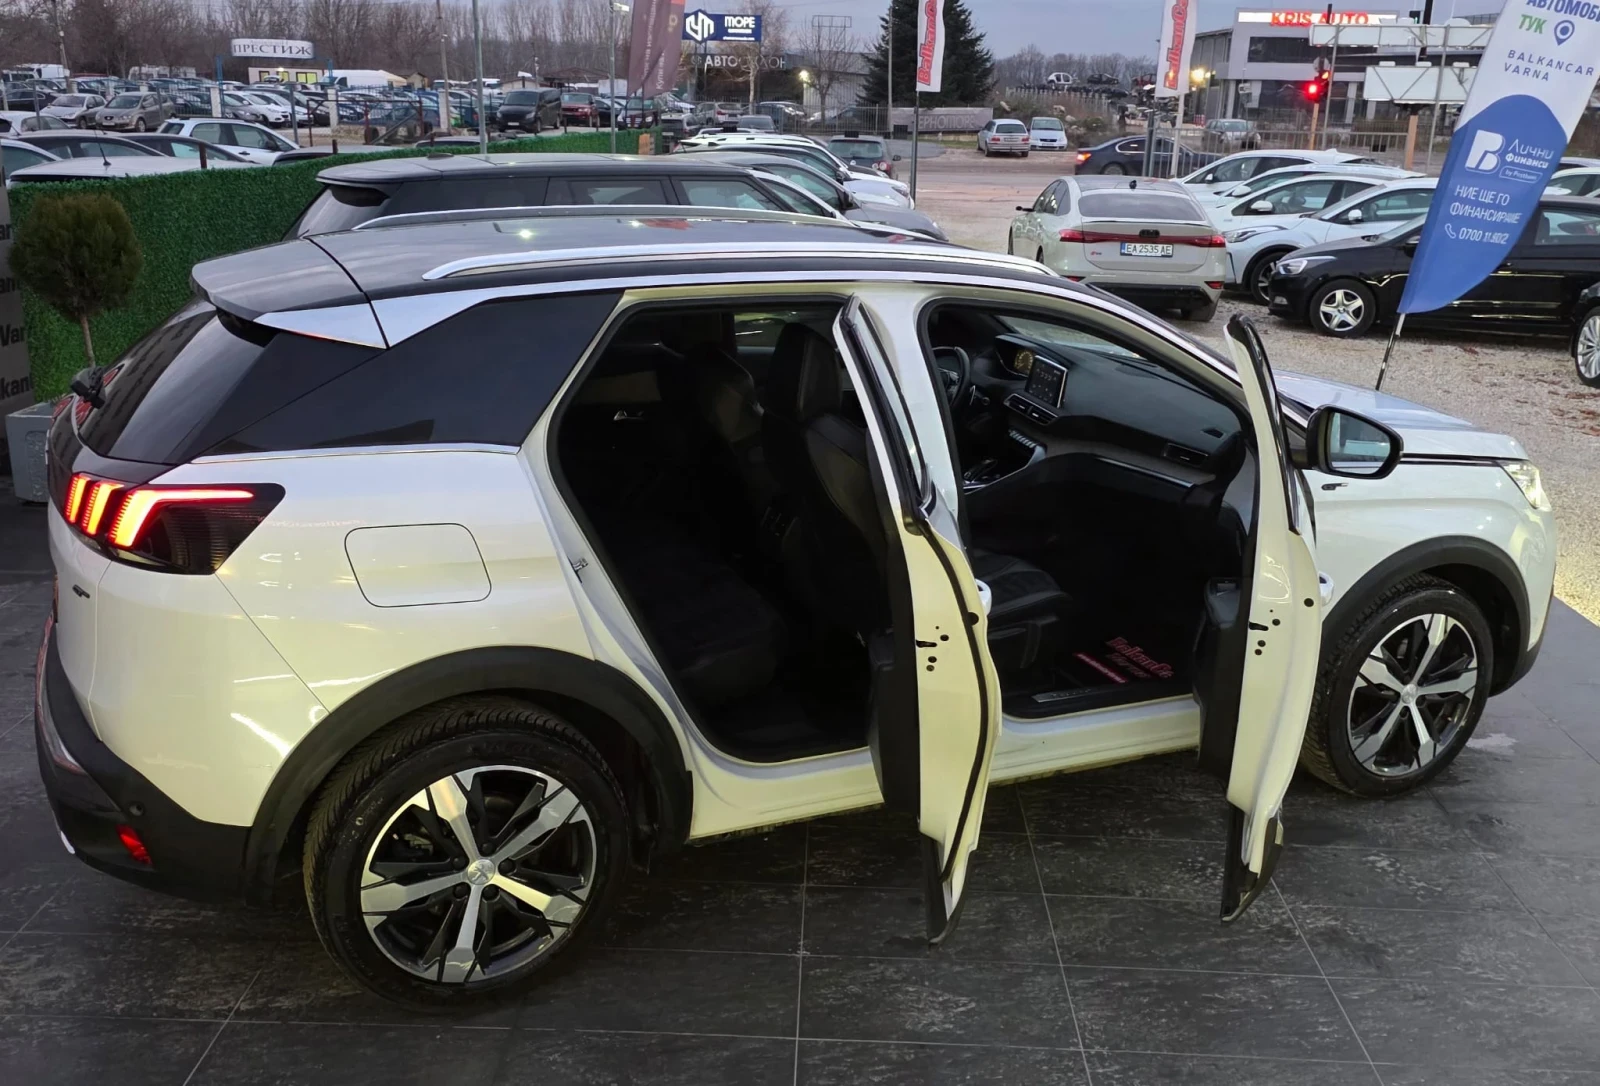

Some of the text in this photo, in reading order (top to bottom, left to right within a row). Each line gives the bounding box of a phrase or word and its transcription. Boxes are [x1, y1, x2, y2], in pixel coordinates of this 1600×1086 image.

[1270, 11, 1369, 26] KRIS AUTO
[1519, 14, 1547, 34] ТУК
[233, 44, 312, 55] ПРЕСТИЖ
[1504, 62, 1549, 81] VARNA
[1508, 50, 1594, 76] BALKANCAR
[1508, 139, 1554, 160] Лични
[1454, 185, 1510, 206] НИЕ ЩЕ ГО
[1459, 227, 1483, 242] 0700
[1126, 244, 1171, 255] EA 2535 AE
